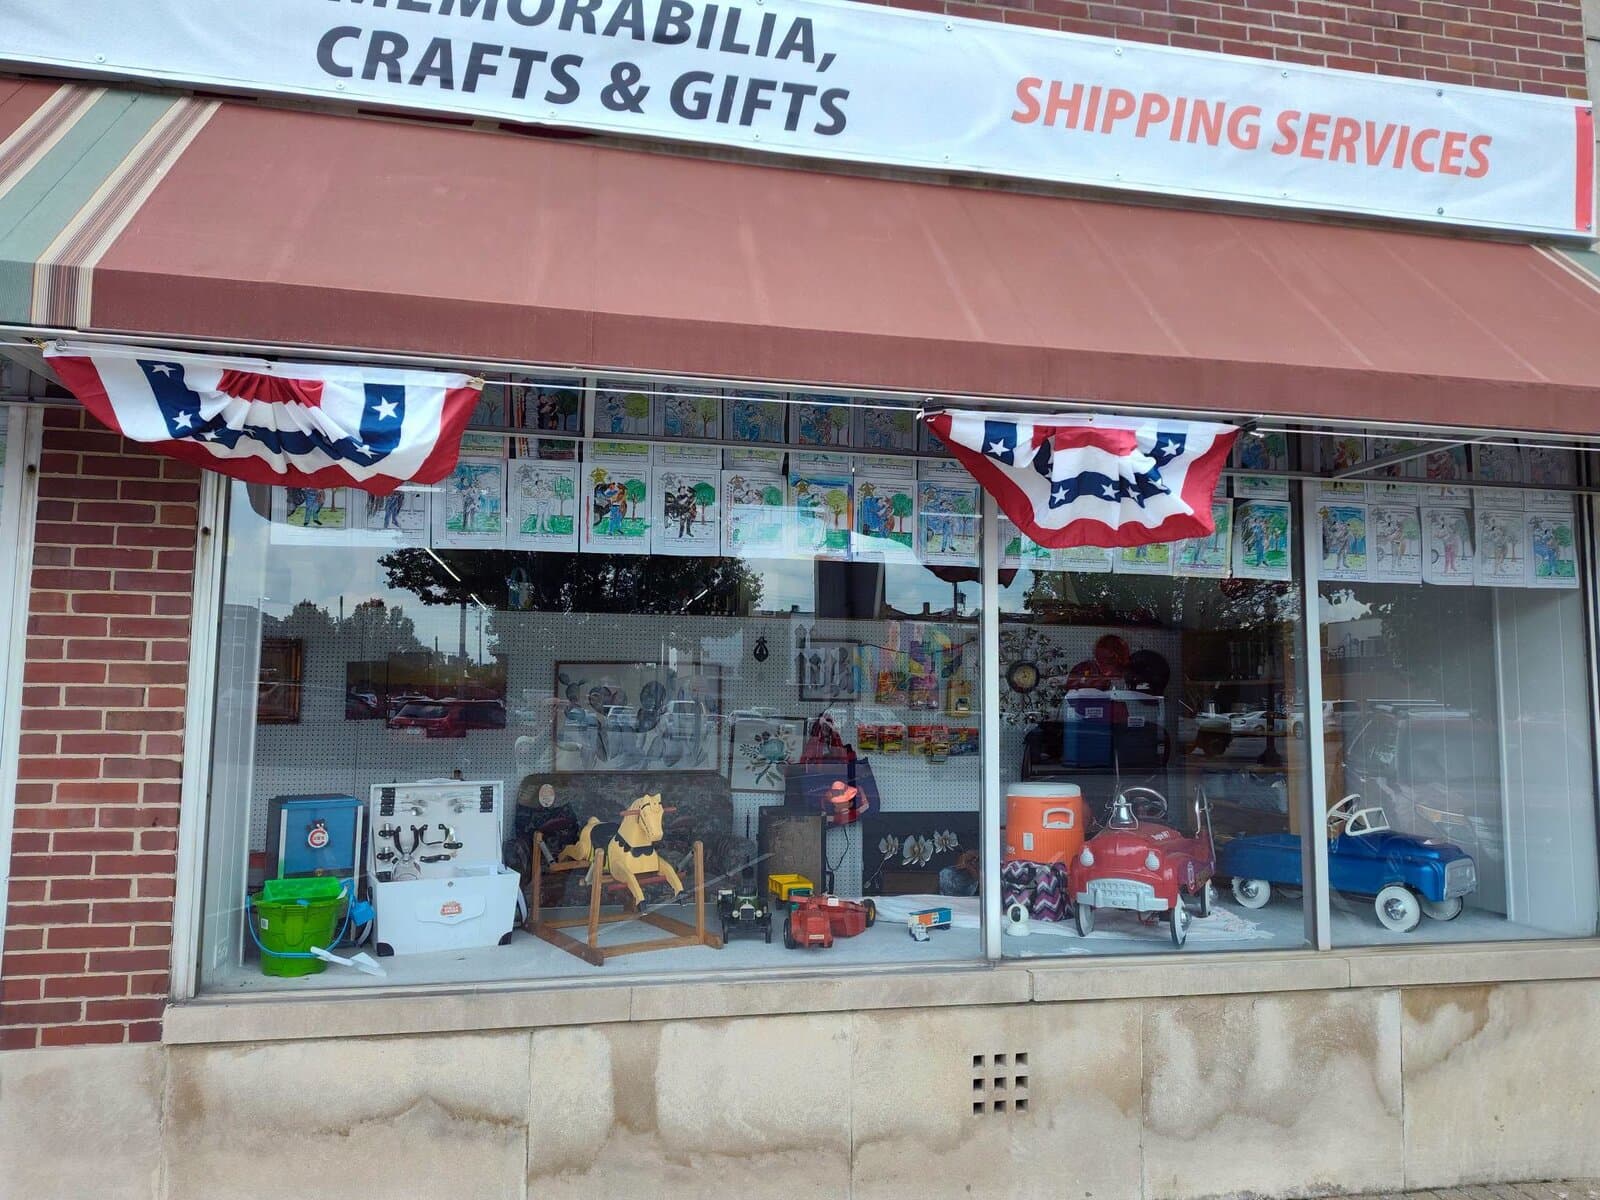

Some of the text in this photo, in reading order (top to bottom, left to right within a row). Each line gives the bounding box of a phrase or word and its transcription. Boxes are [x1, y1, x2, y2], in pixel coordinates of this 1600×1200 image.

[317, 26, 850, 136] CRAFTS & GIFTS
[328, 0, 836, 73] ORABILIA,
[1012, 77, 1492, 178] SHIPPING SERVICES
